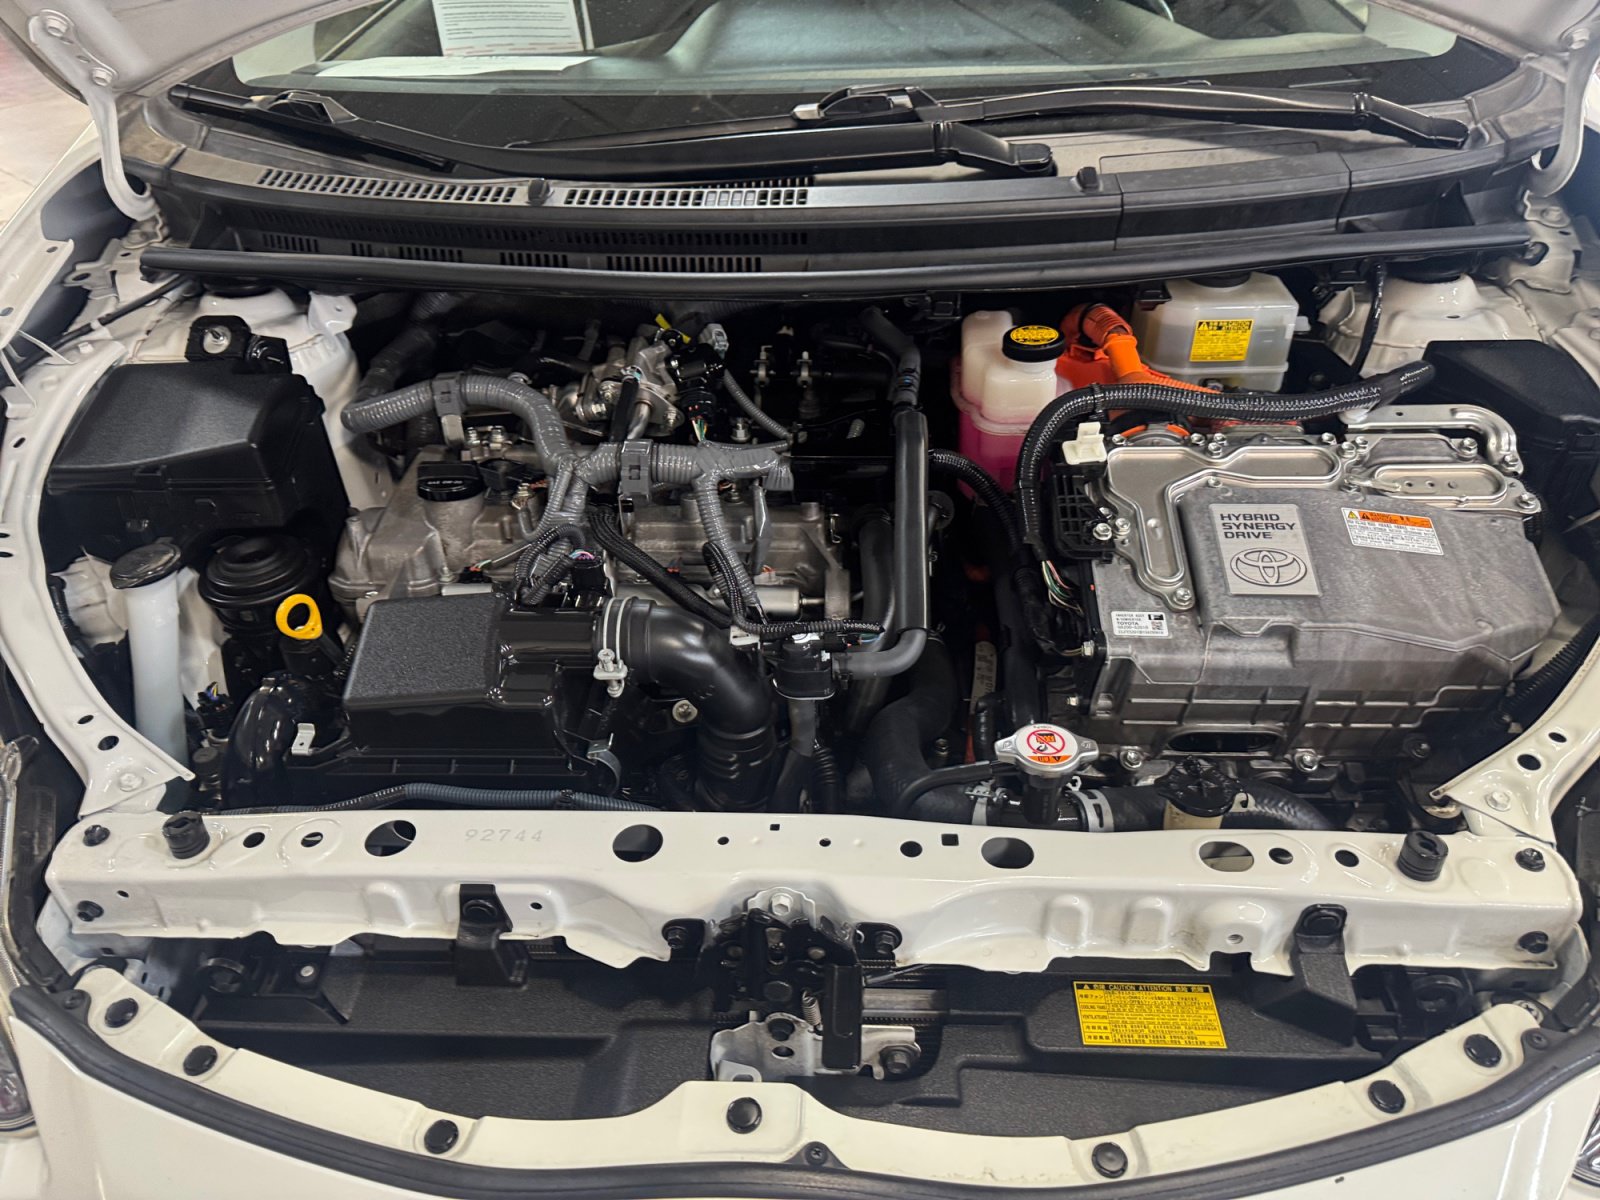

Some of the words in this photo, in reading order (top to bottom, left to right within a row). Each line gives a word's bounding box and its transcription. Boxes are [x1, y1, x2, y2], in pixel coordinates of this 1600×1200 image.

[1220, 513, 1280, 521] HYBRID
[1222, 522, 1296, 530] SYNERGY
[1224, 531, 1273, 539] DRIVE
[464, 828, 543, 842] 92744
